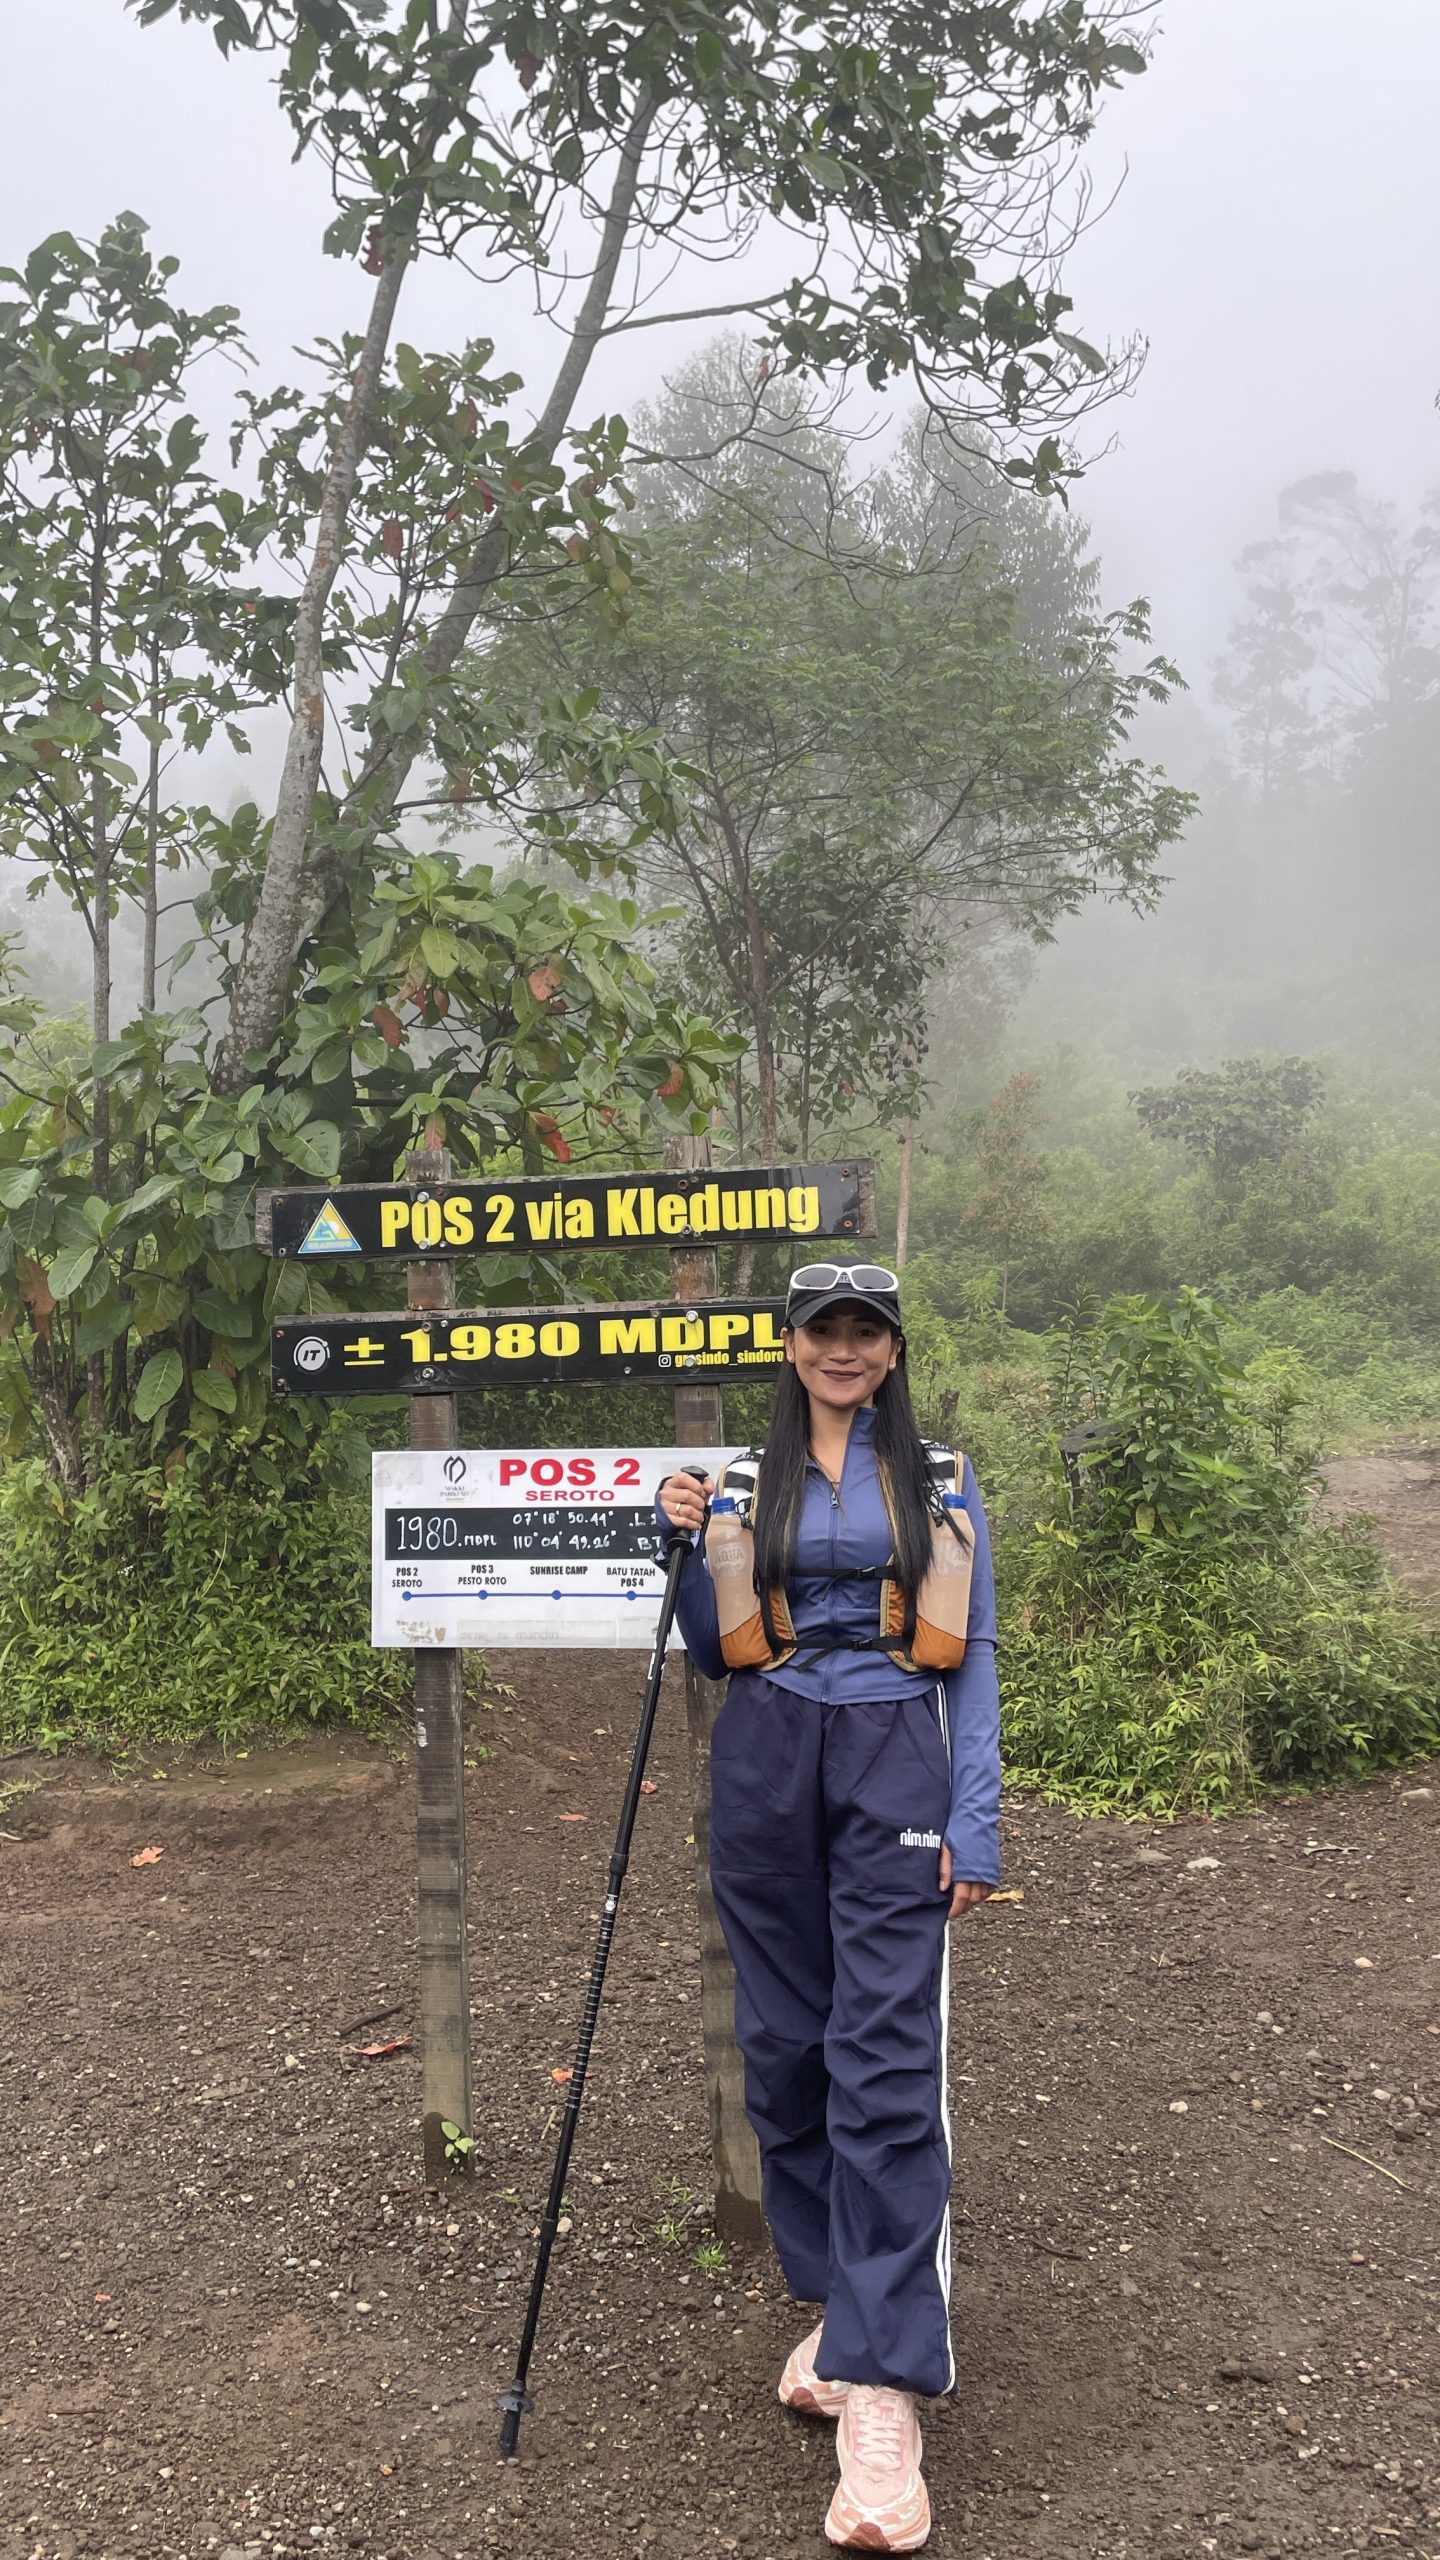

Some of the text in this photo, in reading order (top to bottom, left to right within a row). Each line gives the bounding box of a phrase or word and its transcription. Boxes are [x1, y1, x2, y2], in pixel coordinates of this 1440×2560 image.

[380, 1184, 820, 1248] POS 2 via Kledung
[400, 1321, 580, 1363] 1.980
[600, 1312, 785, 1355] MDPL
[500, 1458, 641, 1486] POS 2
[525, 1490, 615, 1501] SEROTO
[396, 1567, 419, 1577] POS 2
[471, 1564, 494, 1574] POS 3
[530, 1566, 588, 1576] SUNRISE CAMP
[606, 1567, 628, 1576] BATU
[630, 1567, 656, 1577] TATAH
[391, 1579, 423, 1588] SEROTO
[458, 1576, 507, 1585] PESTO ROTO
[620, 1578, 644, 1587] POS 4
